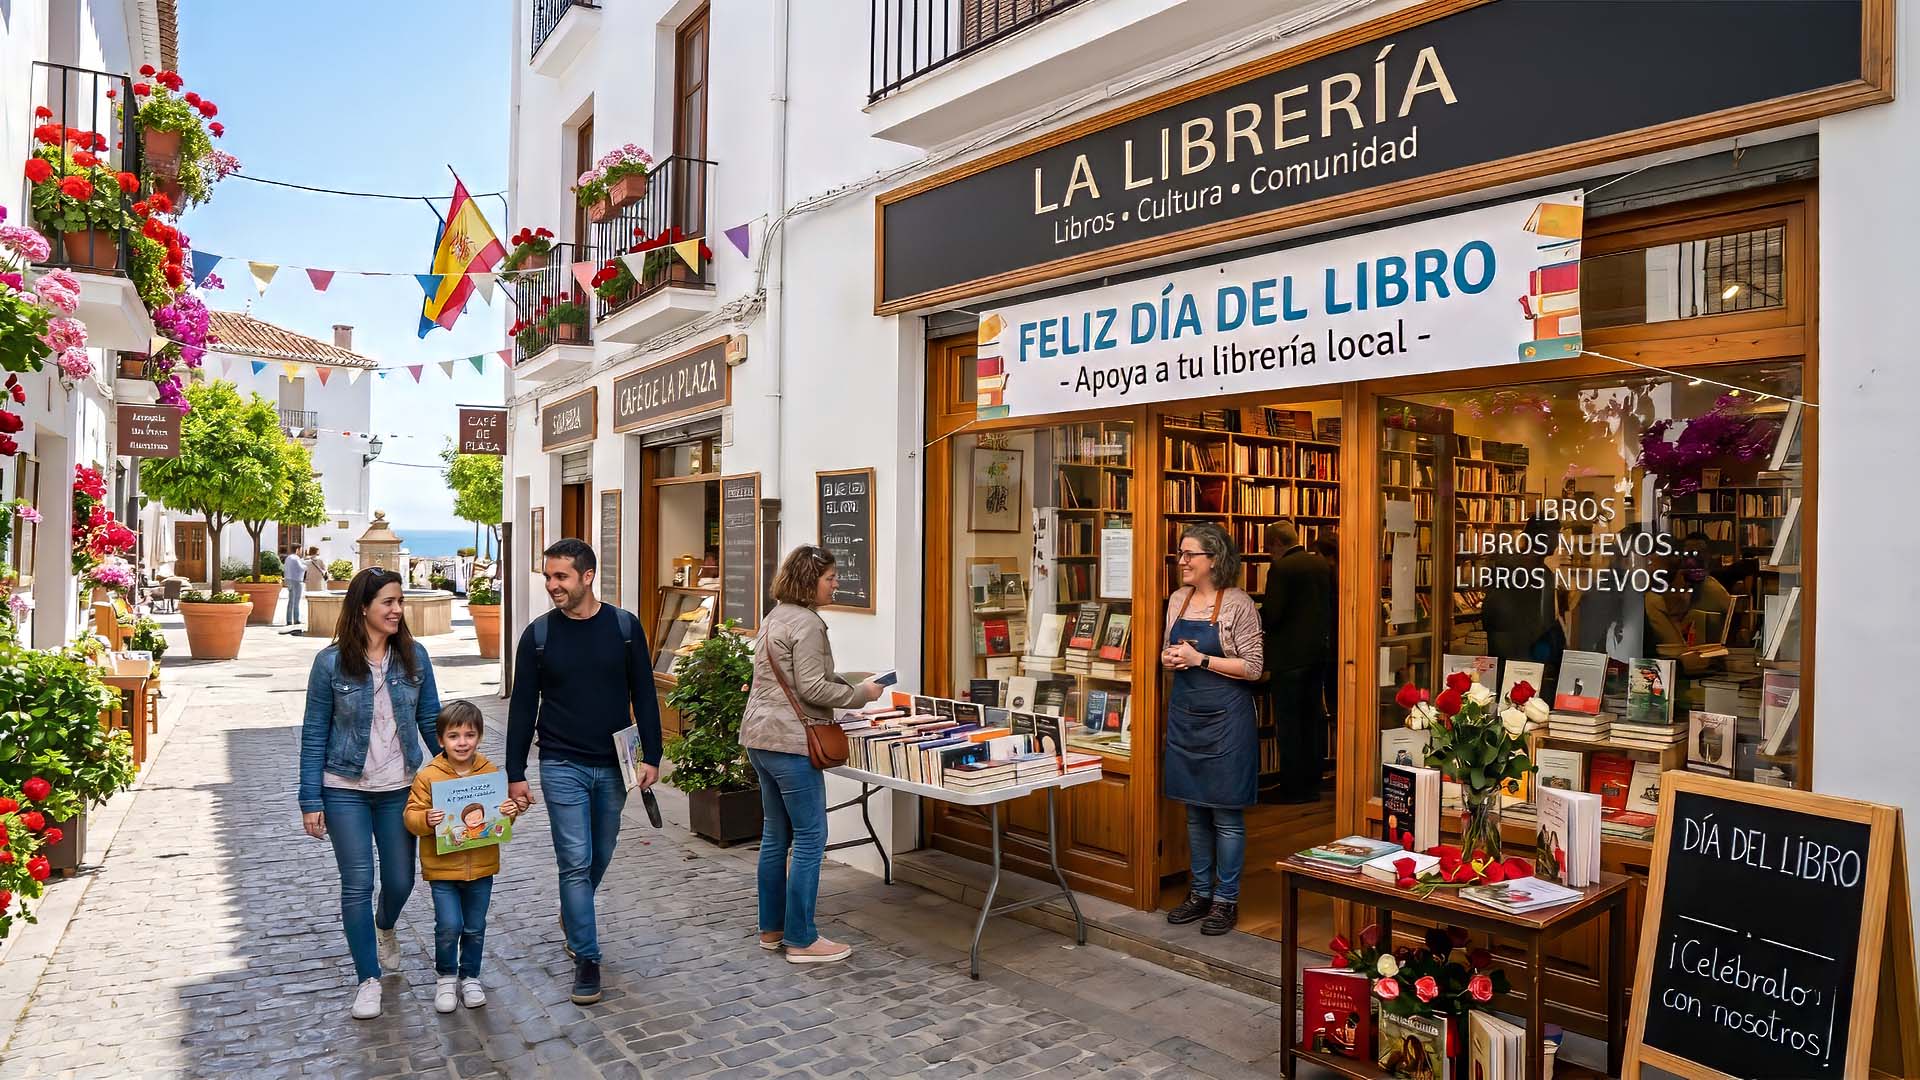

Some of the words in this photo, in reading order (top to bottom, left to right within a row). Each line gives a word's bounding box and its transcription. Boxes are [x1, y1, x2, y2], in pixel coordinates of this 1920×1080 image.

[1033, 153, 1101, 215] LA
[1124, 43, 1458, 191] LIBRERÍA
[1053, 209, 1115, 244] Libros
[1137, 181, 1223, 223] Cultura
[1249, 125, 1419, 195] Comunidad
[1018, 309, 1118, 362] FELIZ
[1130, 282, 1203, 346] DÍA
[1216, 276, 1308, 332] DEL
[1325, 239, 1497, 314] LIBRO
[1075, 364, 1147, 397] Apoya
[1155, 359, 1169, 382] a
[1177, 353, 1203, 379] tu
[1212, 334, 1316, 376] librería
[1327, 319, 1407, 361] local
[620, 375, 643, 417] CAFÉ
[644, 379, 660, 409] DE
[661, 373, 675, 405] LA
[678, 359, 717, 400] PLAZA
[1520, 497, 1616, 522] LIBROS
[1458, 532, 1549, 555] LIBROS
[1557, 532, 1699, 557] NUEVOS...
[1455, 566, 1546, 590] LIBROS
[1554, 567, 1694, 593] NUEVOS...
[1683, 813, 1721, 859] DÍA
[1730, 826, 1772, 870] DEL
[1663, 988, 1701, 1017] con
